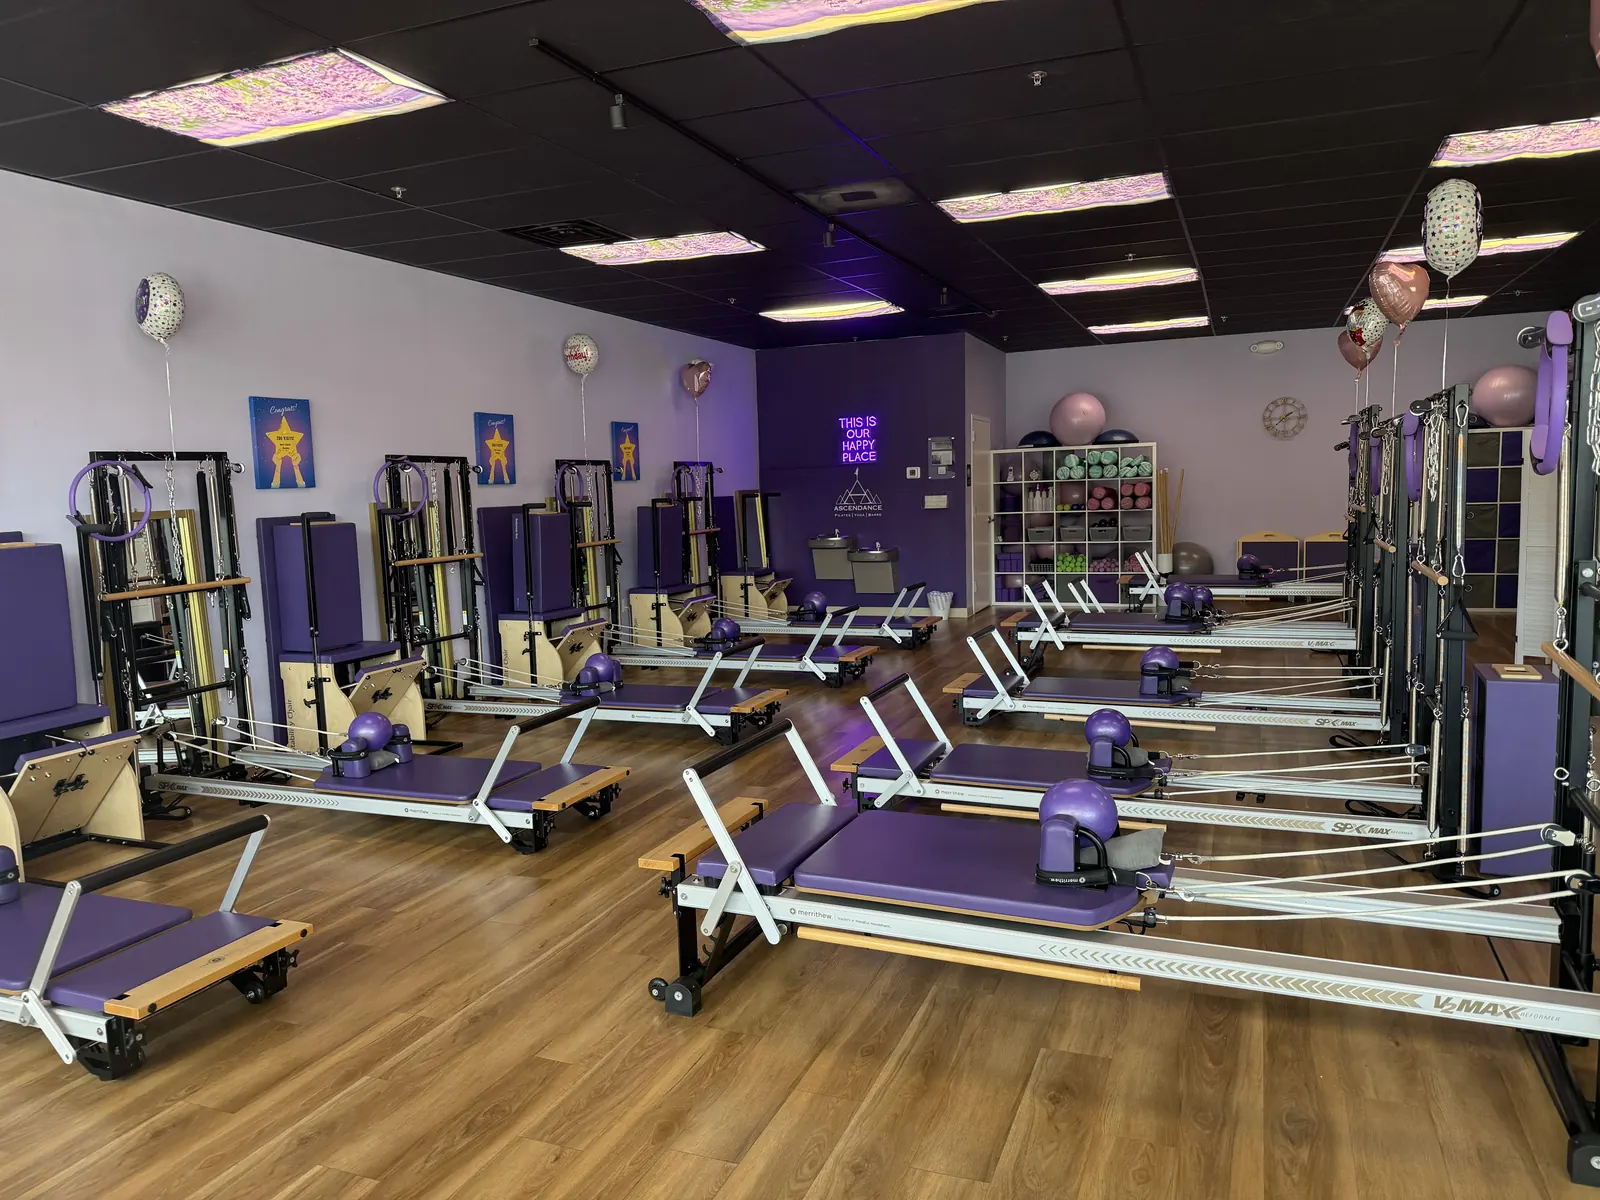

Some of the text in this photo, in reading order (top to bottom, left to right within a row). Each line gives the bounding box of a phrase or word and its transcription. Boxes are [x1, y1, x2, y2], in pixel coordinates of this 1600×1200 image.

[839, 416, 877, 428] THIS IS
[846, 429, 870, 438] OUR
[842, 439, 875, 451] HAPPY
[842, 451, 876, 462] PLACE
[1367, 827, 1392, 835] MAX
[797, 909, 833, 920] merrithew
[1520, 1012, 1561, 1022] REFORMER
